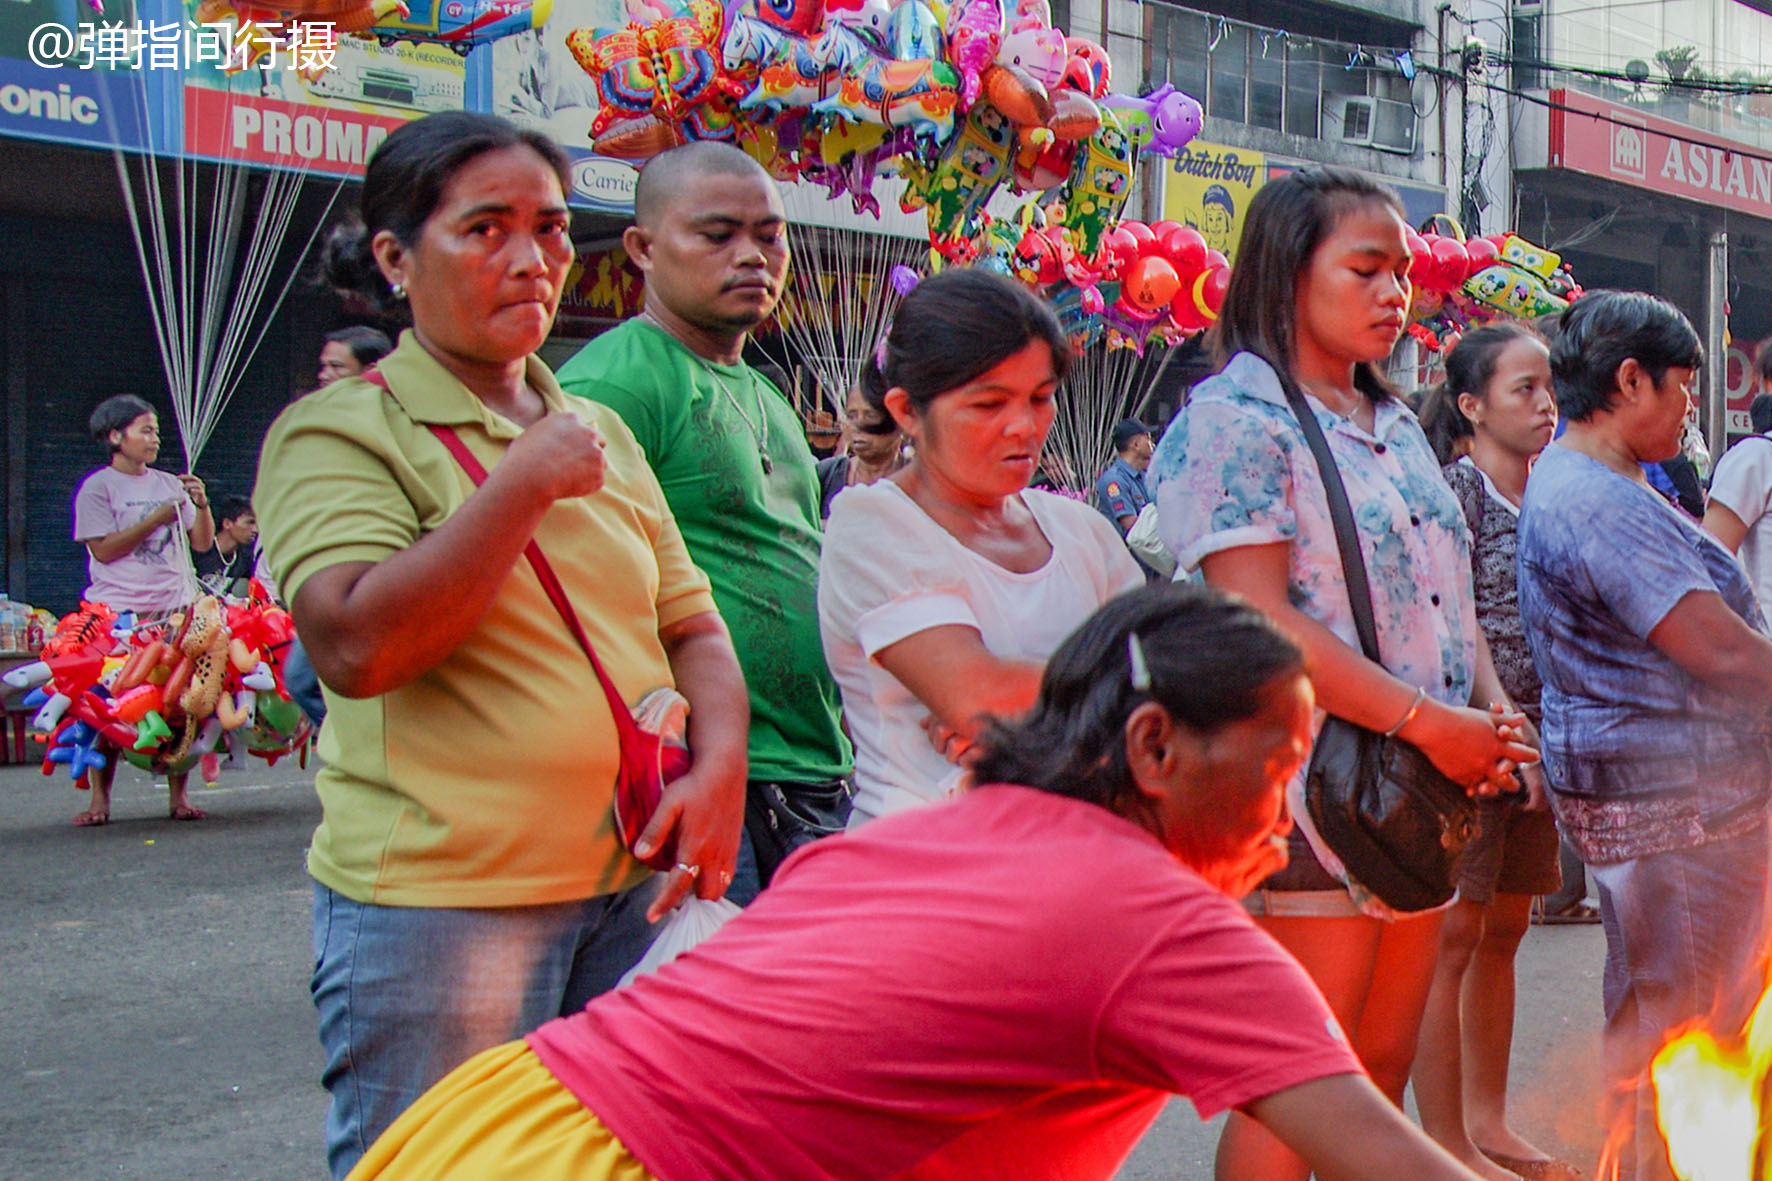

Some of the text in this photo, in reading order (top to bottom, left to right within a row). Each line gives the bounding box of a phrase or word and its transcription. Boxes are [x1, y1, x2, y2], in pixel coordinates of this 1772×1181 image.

[362, 41, 394, 56] STUDIO
[0, 83, 99, 125] onic
[581, 166, 634, 193] Carrie
[1174, 147, 1257, 189] Dutch Boy
